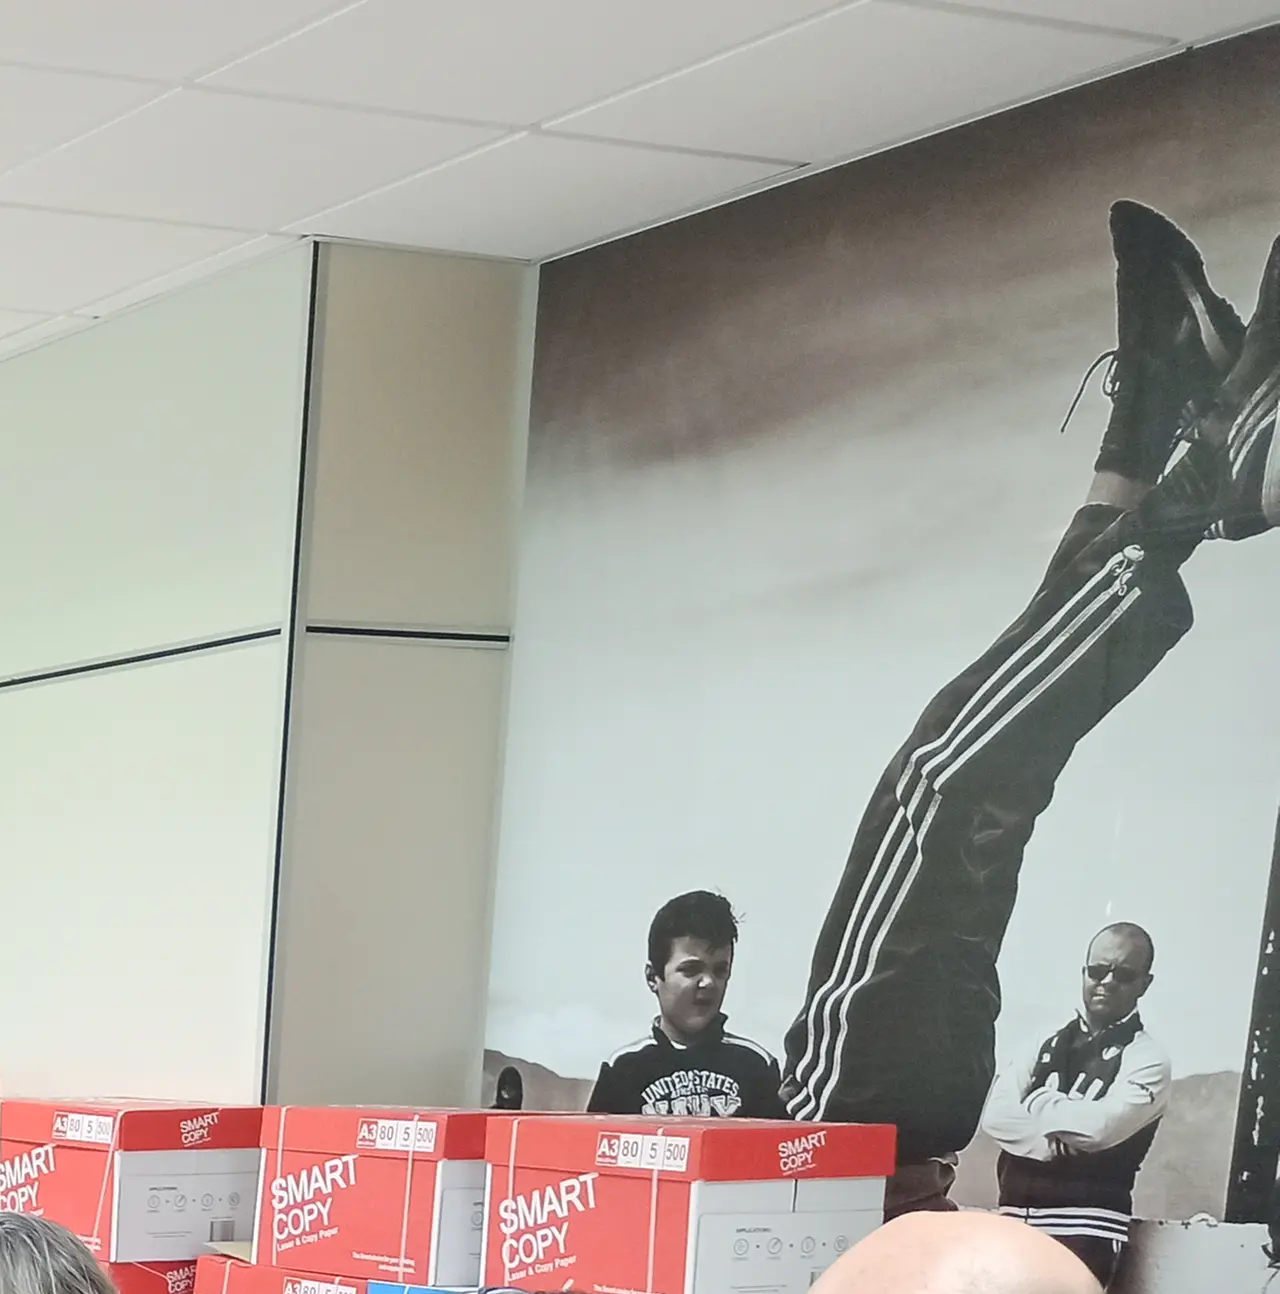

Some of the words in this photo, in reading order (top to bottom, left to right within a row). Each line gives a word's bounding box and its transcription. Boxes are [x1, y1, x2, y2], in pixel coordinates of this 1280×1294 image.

[641, 1070, 689, 1104] UNITED
[693, 1069, 740, 1097] STATES
[53, 1117, 68, 1131] A3
[69, 1119, 81, 1133] 80
[86, 1120, 93, 1133] 5
[97, 1121, 111, 1136] 500
[180, 1112, 219, 1133] SMART
[182, 1128, 209, 1144] COPY
[358, 1123, 376, 1140] A3
[379, 1125, 394, 1141] 80
[402, 1126, 410, 1142] 5
[416, 1128, 434, 1143] 500
[598, 1138, 619, 1156] A3
[621, 1140, 638, 1158] 80
[649, 1142, 658, 1159] 5
[666, 1143, 686, 1161] 500
[778, 1131, 827, 1158] SMART
[779, 1151, 813, 1171] COPY
[271, 1154, 360, 1210] SMART
[499, 1172, 600, 1234] SMART
[273, 1197, 332, 1240] COPY
[302, 1233, 318, 1245] Copy
[319, 1227, 340, 1240] Paper
[502, 1221, 569, 1269] COPY
[534, 1260, 554, 1274] Copy
[555, 1254, 577, 1269] Paper
[167, 1266, 197, 1283] SMAR
[168, 1278, 194, 1294] COPY
